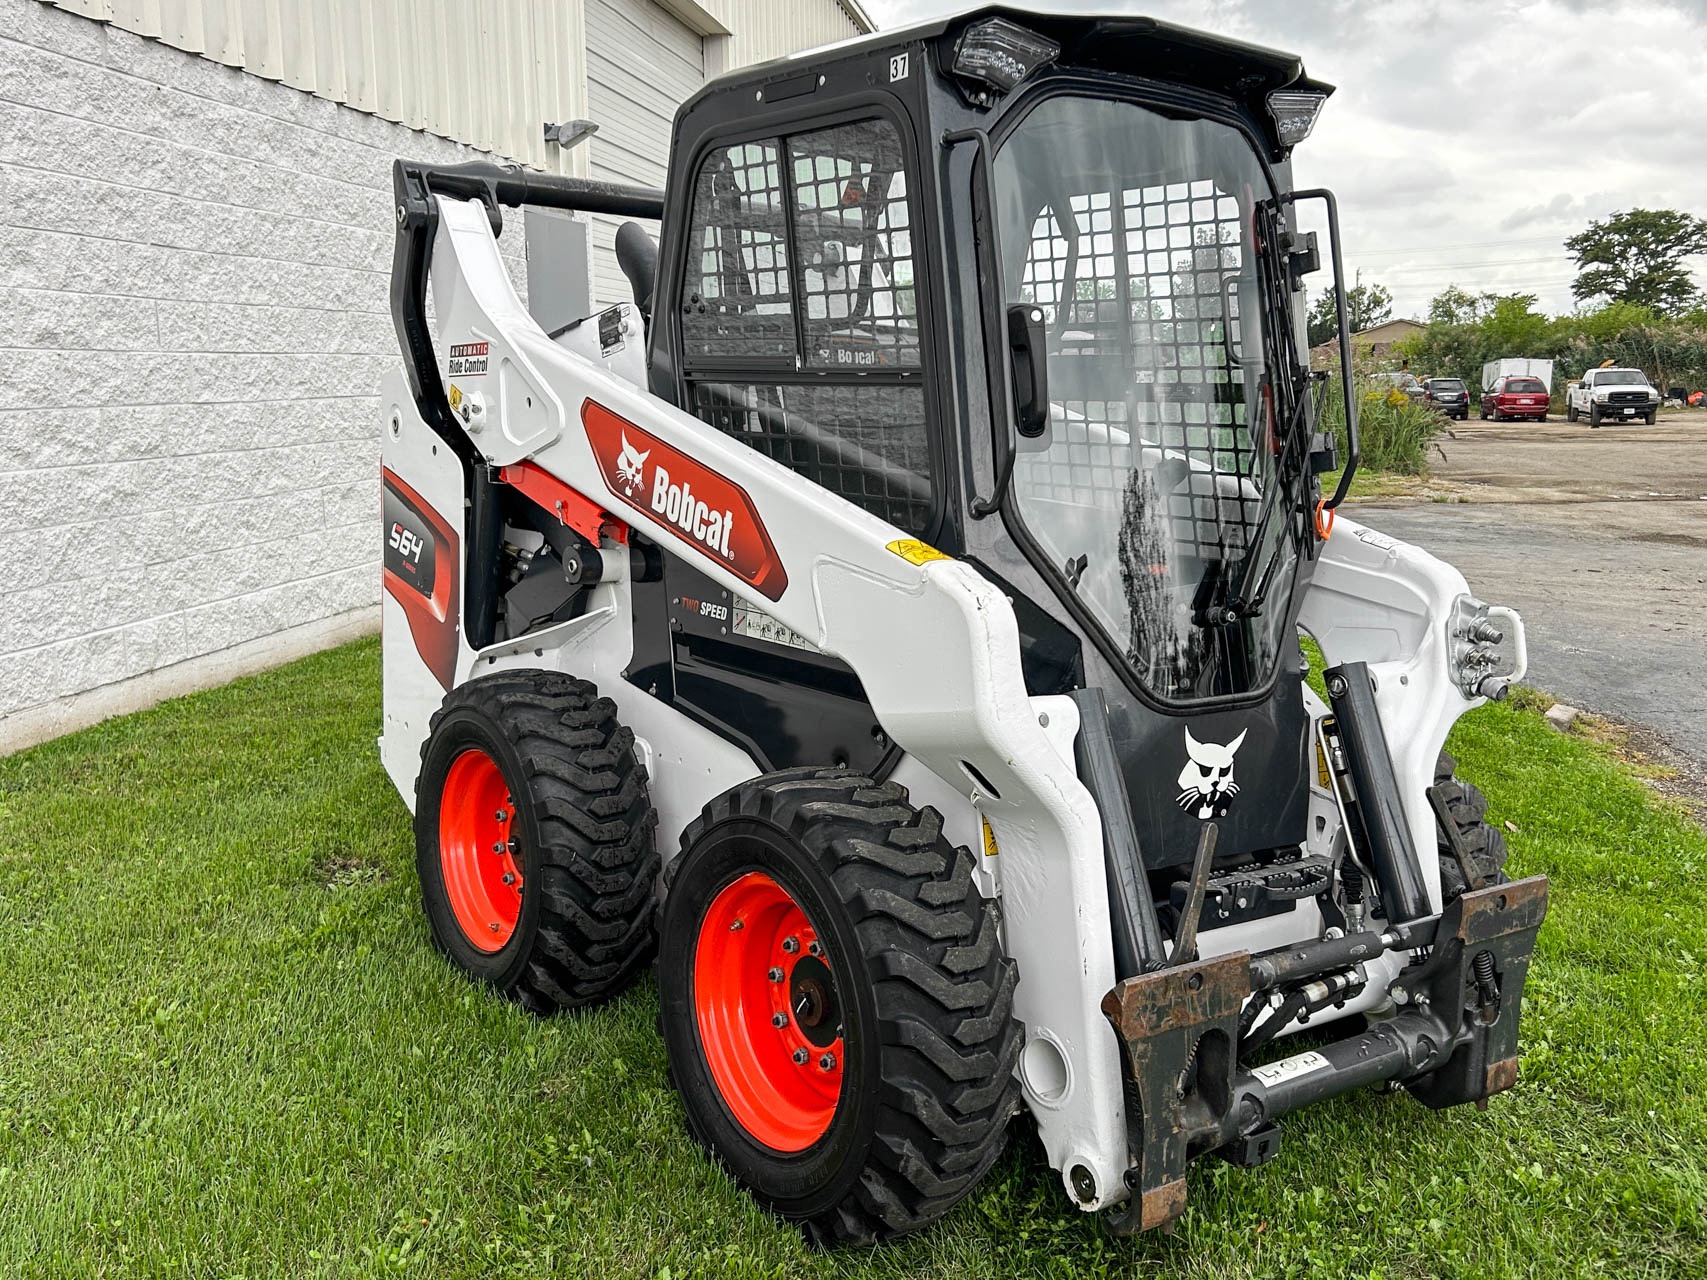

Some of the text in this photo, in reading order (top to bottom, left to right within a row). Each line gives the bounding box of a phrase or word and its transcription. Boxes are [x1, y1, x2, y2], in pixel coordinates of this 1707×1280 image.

[892, 56, 906, 78] 37
[451, 344, 488, 357] AUTOMATIC
[448, 357, 488, 374] Ride Control
[651, 465, 733, 558] Bobcat
[389, 522, 423, 564] S64
[682, 597, 727, 621] TWO SPEED
